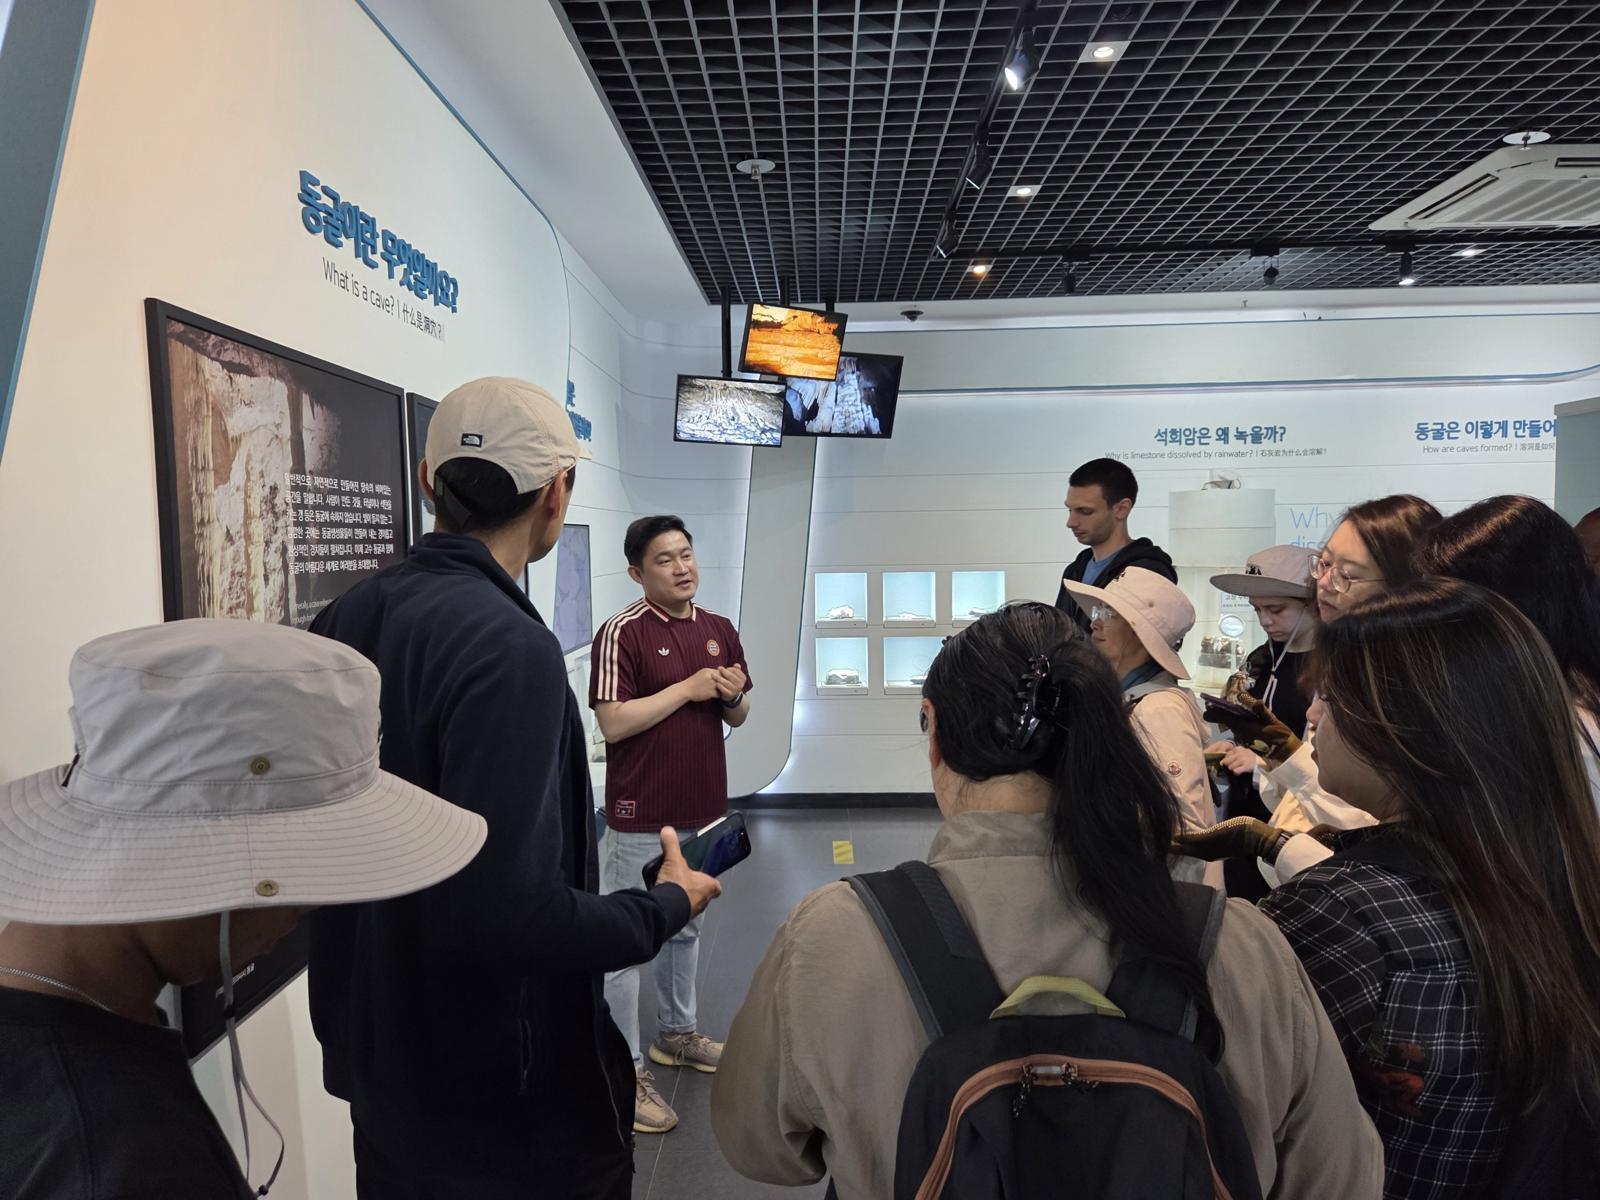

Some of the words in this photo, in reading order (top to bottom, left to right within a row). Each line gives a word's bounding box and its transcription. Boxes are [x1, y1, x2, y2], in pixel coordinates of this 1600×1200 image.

[298, 170, 379, 269] 동굴이란
[380, 229, 458, 313] 무엇일까요?
[323, 256, 349, 292] What
[351, 273, 360, 297] is
[362, 285, 368, 301] a
[370, 290, 395, 316] cave?
[1154, 427, 1211, 446] 석회암은
[1215, 426, 1229, 445] 왜
[1234, 425, 1286, 444] 녹을까?
[1415, 421, 1460, 441] 동굴은
[1465, 420, 1508, 439] 이렇게
[1104, 451, 1121, 460] Why
[1122, 451, 1129, 459] is
[1131, 451, 1165, 459] limestone
[1167, 450, 1202, 459] dissolved
[1203, 450, 1212, 460] by
[1214, 449, 1253, 458] rainwater?
[1423, 445, 1440, 454] How
[1456, 445, 1478, 453] caves
[1480, 443, 1512, 452] formed?
